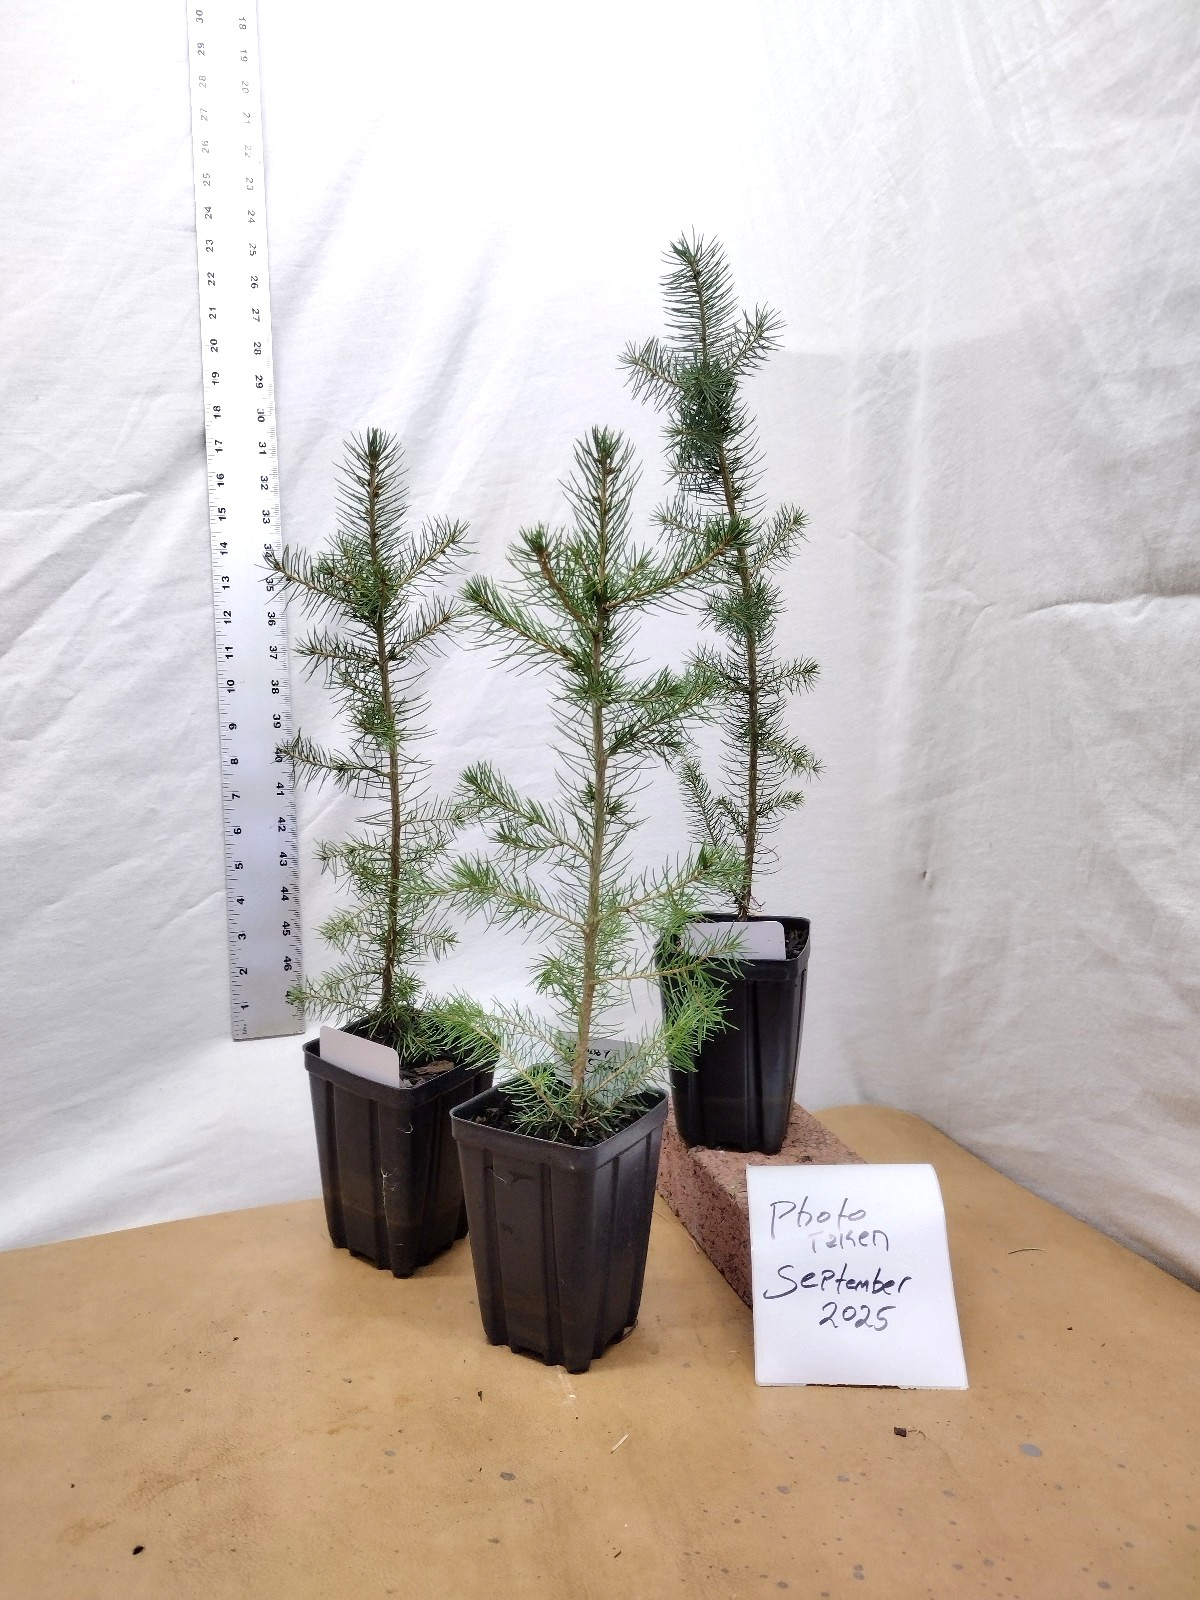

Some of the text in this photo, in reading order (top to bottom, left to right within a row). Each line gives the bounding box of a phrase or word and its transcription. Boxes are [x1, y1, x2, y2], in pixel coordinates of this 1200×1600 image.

[196, 10, 203, 23] 30
[239, 16, 246, 30] 18
[197, 42, 205, 56] 29
[199, 75, 206, 88] 28
[242, 81, 249, 93] 20
[200, 108, 208, 121] 27
[203, 173, 210, 186] 25
[246, 177, 253, 190] 23
[204, 206, 212, 219] 24
[247, 210, 255, 224] 24
[206, 239, 214, 252] 23
[249, 243, 256, 256] 25
[207, 272, 215, 286] 22
[251, 276, 258, 289] 26
[209, 307, 216, 319] 21
[252, 308, 260, 322] 27
[210, 338, 218, 352] 20
[253, 342, 262, 355] 28
[212, 372, 220, 385] 19
[255, 375, 263, 388] 29
[213, 405, 221, 419] 18
[257, 409, 265, 422] 30
[215, 439, 223, 453] 17
[258, 442, 267, 455] 31
[216, 473, 225, 486] 16
[260, 476, 268, 490] 32
[218, 508, 226, 521] 15
[262, 510, 270, 524] 33
[220, 542, 228, 555] 14
[221, 576, 230, 590] 13
[265, 578, 274, 592] 35
[223, 610, 232, 624] 12
[268, 612, 276, 626] 36
[225, 646, 233, 659] 11
[269, 646, 278, 659] 37
[227, 680, 235, 693] 10
[271, 680, 280, 694] 38
[273, 714, 281, 728] 39
[276, 782, 284, 796] 41
[278, 817, 286, 832] 42
[279, 852, 288, 866] 43
[280, 887, 289, 901] 44
[282, 921, 290, 936] 45
[283, 956, 292, 971] 46
[770, 1196, 867, 1240] Photo
[808, 1230, 888, 1253] Taken
[819, 1302, 896, 1331] 2025
